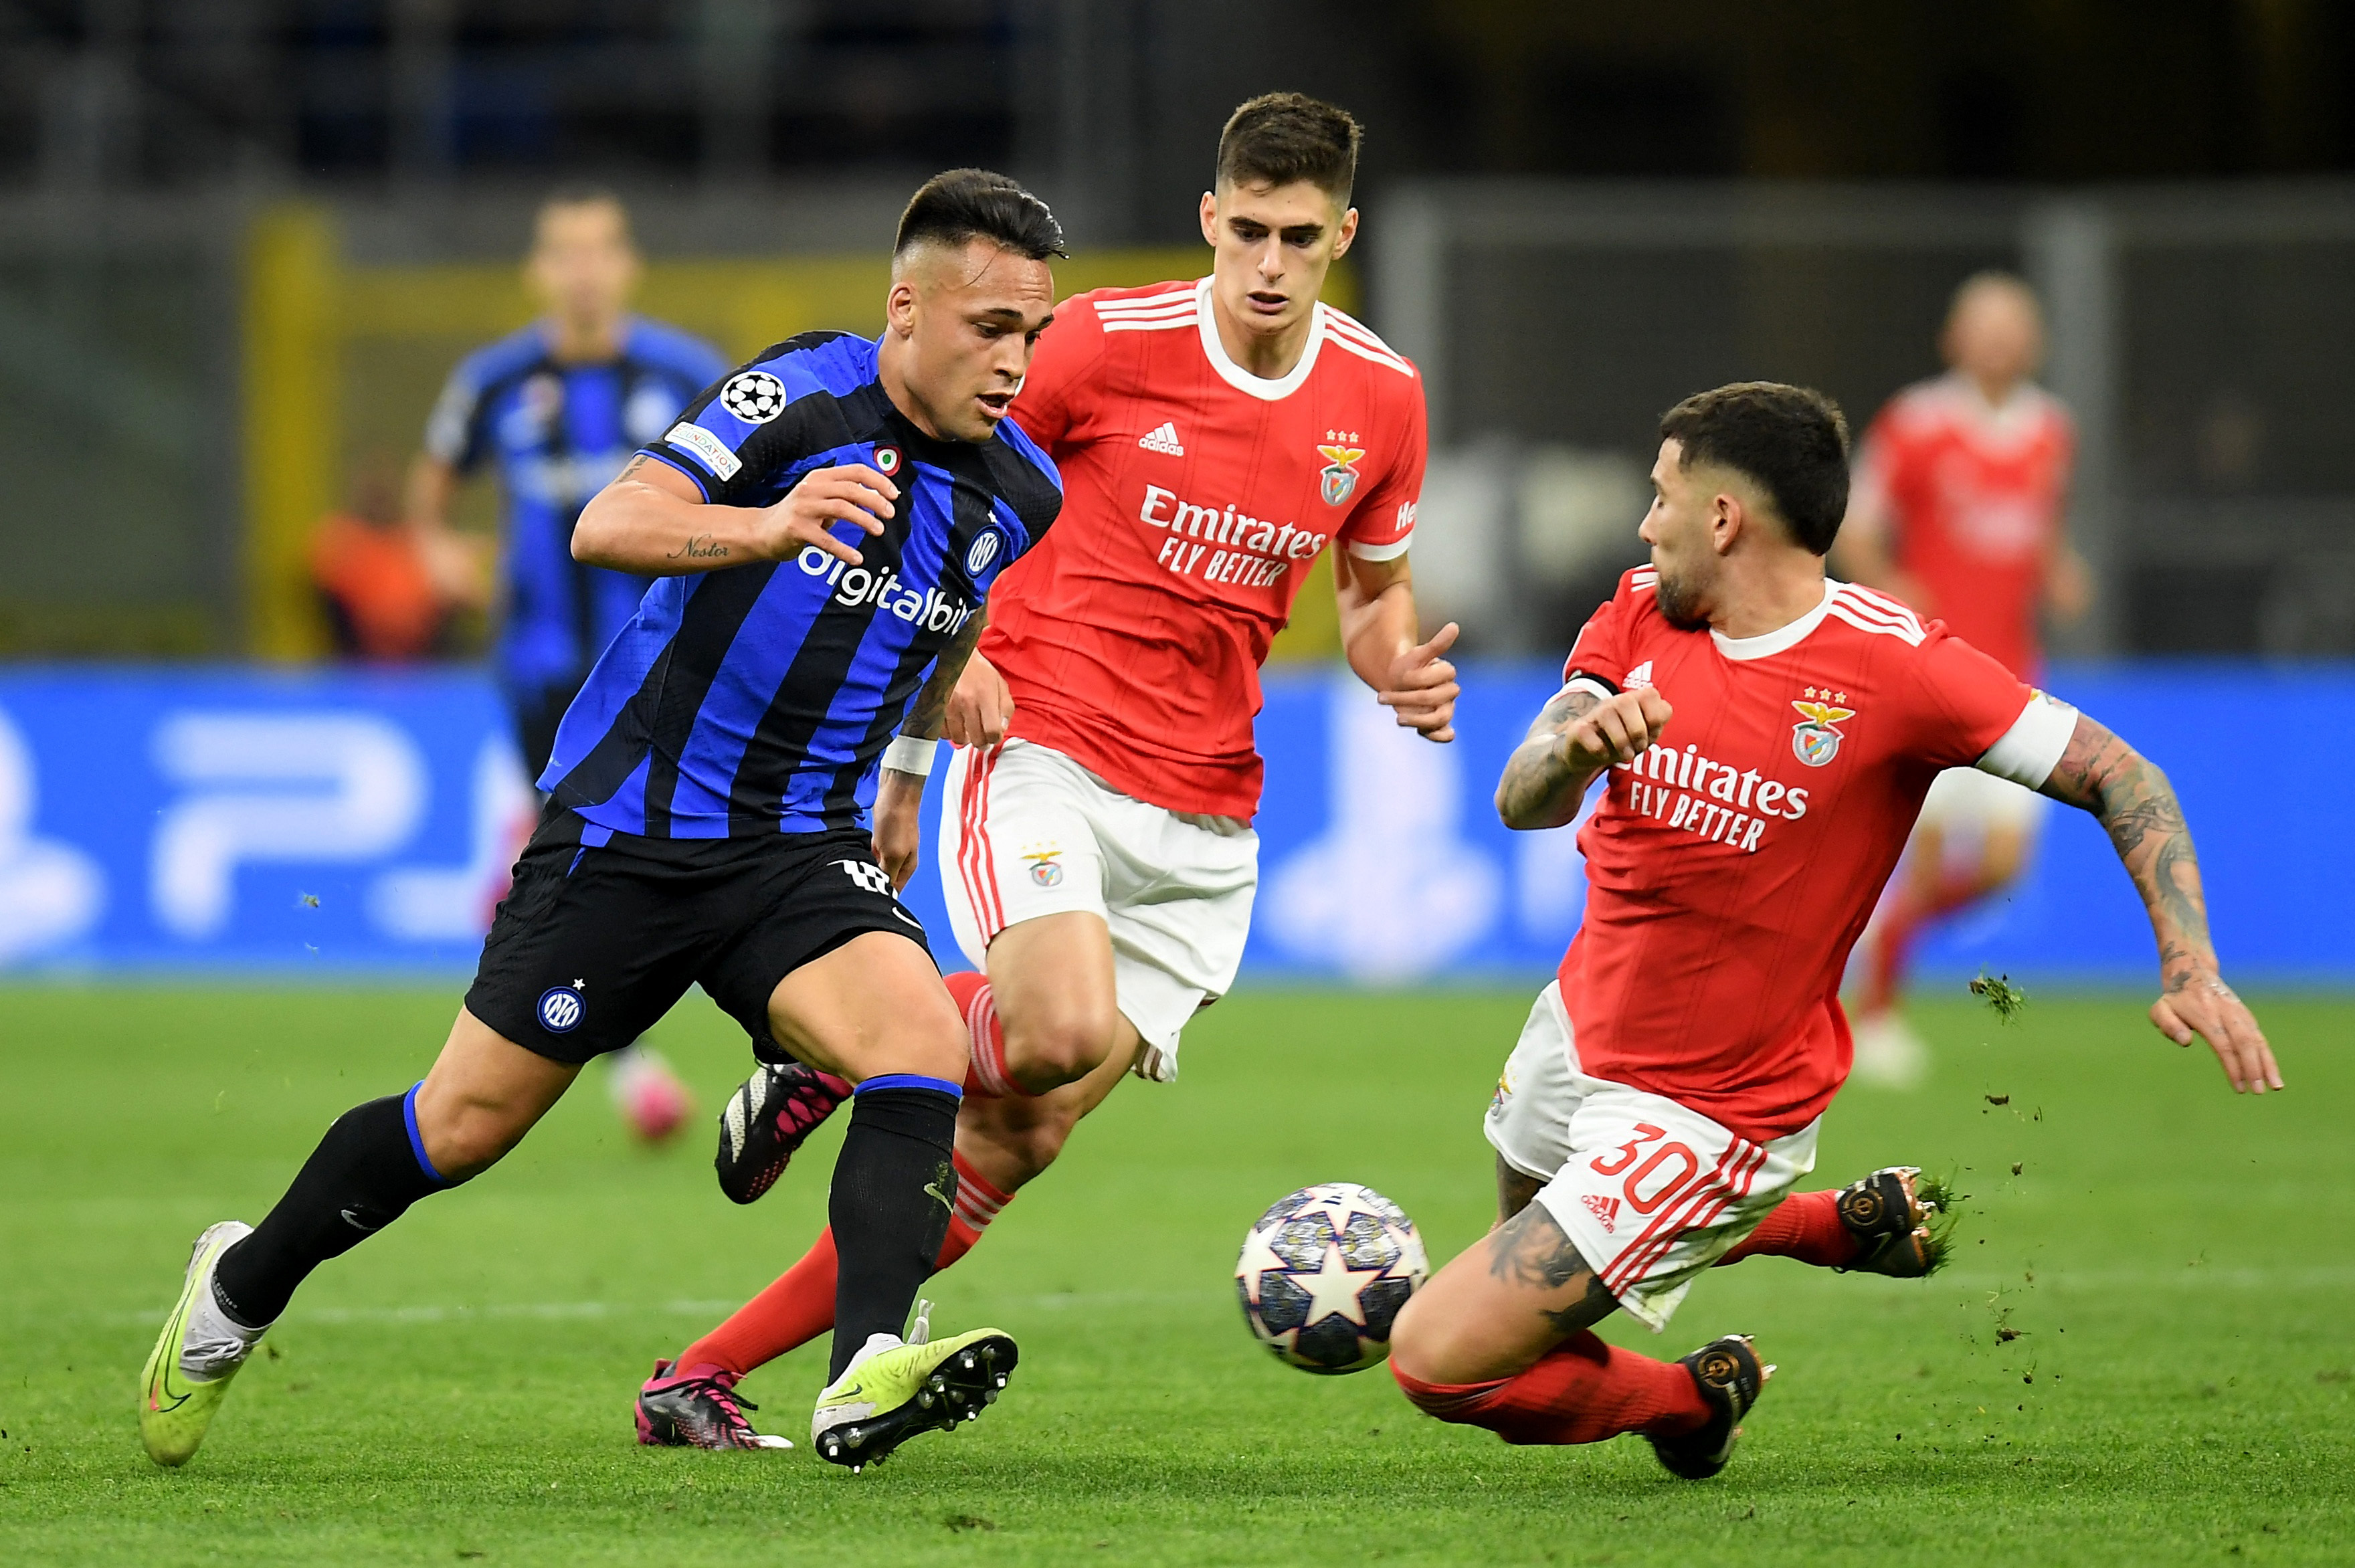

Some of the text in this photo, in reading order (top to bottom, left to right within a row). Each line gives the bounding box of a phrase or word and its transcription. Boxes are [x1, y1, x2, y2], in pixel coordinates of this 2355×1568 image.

[672, 427, 735, 473] FOUNDATION
[1138, 437, 1184, 457] adidas
[667, 533, 728, 559] Nestor
[1139, 484, 1326, 559] Emirates
[1157, 536, 1288, 587] FLY BETTER
[1614, 743, 1809, 820] mirates
[1630, 780, 1766, 852] FLY BETTER
[1590, 1122, 1699, 1214] 30
[1581, 1195, 1615, 1234] adidas
